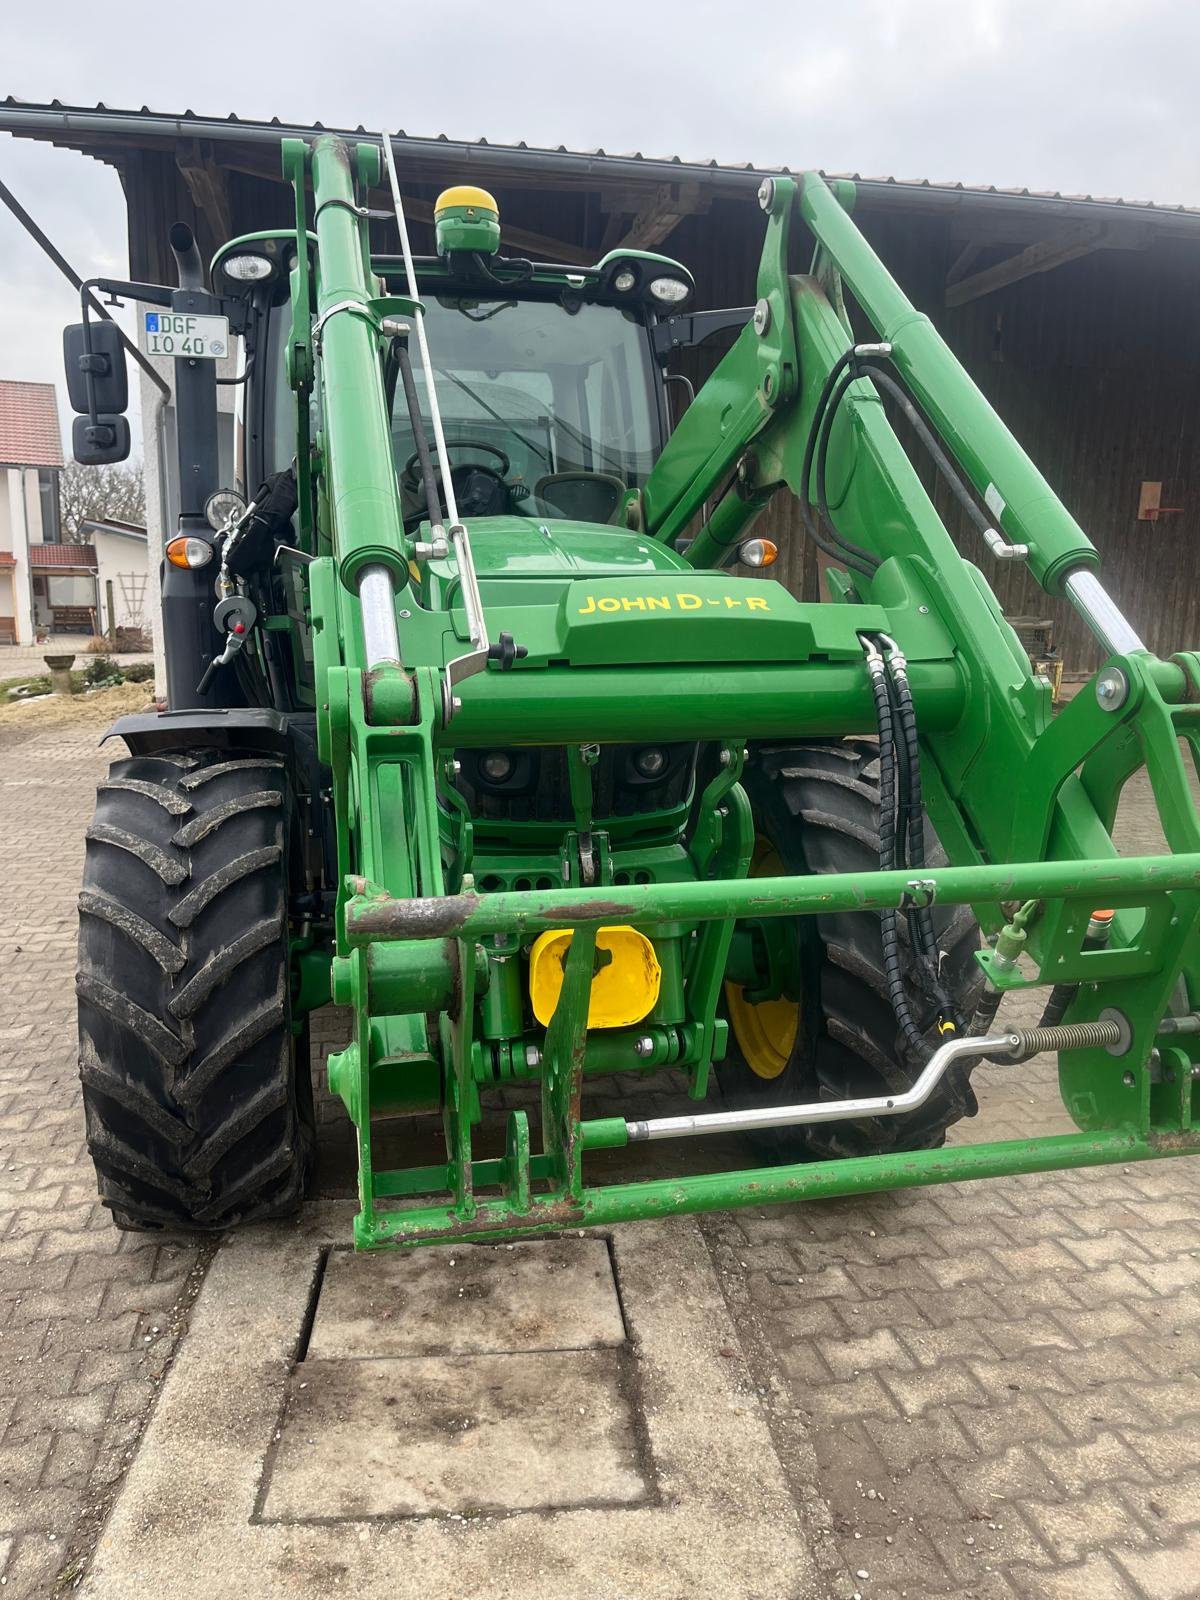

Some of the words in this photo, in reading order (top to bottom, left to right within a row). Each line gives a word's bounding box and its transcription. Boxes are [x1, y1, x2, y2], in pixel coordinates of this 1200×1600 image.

[160, 316, 197, 334] DGF
[182, 337, 204, 354] 40
[578, 596, 671, 615] JOHN
